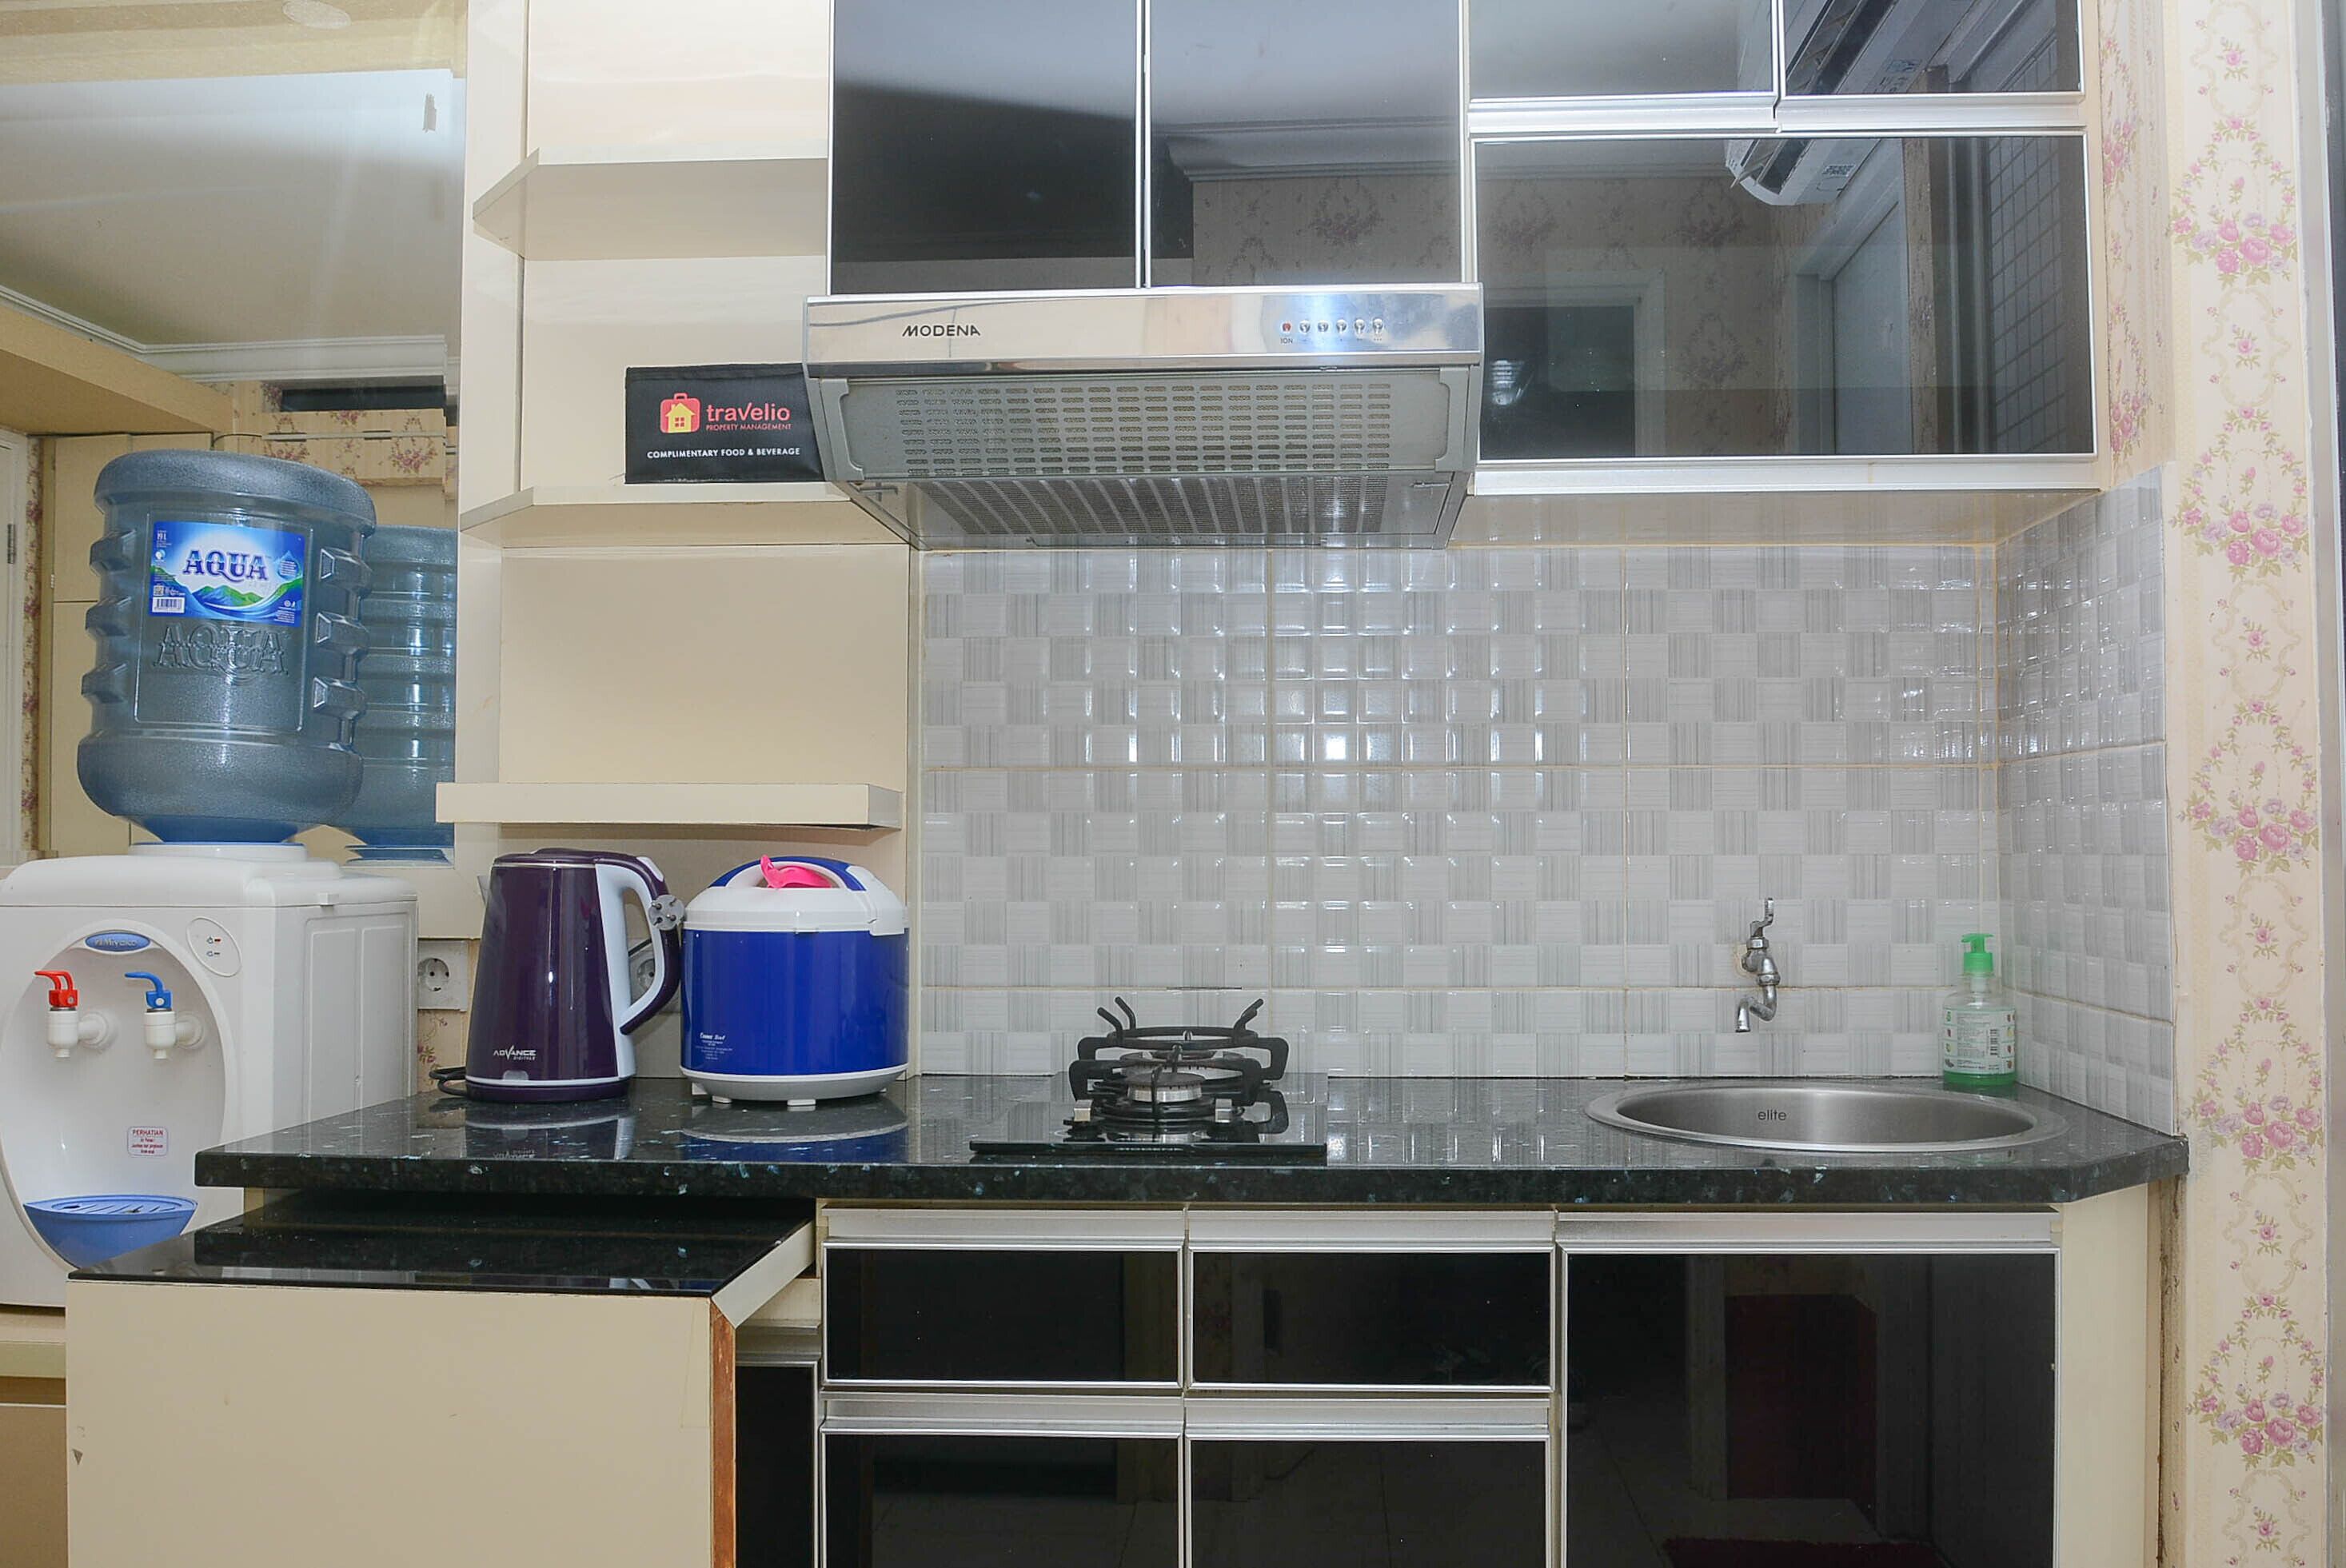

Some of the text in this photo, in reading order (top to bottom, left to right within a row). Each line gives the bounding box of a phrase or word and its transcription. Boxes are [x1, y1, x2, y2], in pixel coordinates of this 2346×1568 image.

[902, 325, 981, 337] MODENA
[706, 402, 791, 421] travelio
[647, 449, 718, 458] COMPLIMENTARY
[183, 550, 268, 582] AQUA
[153, 623, 289, 681] AQUA
[493, 1045, 537, 1060] ADVANCE
[1758, 1109, 1787, 1121] elite
